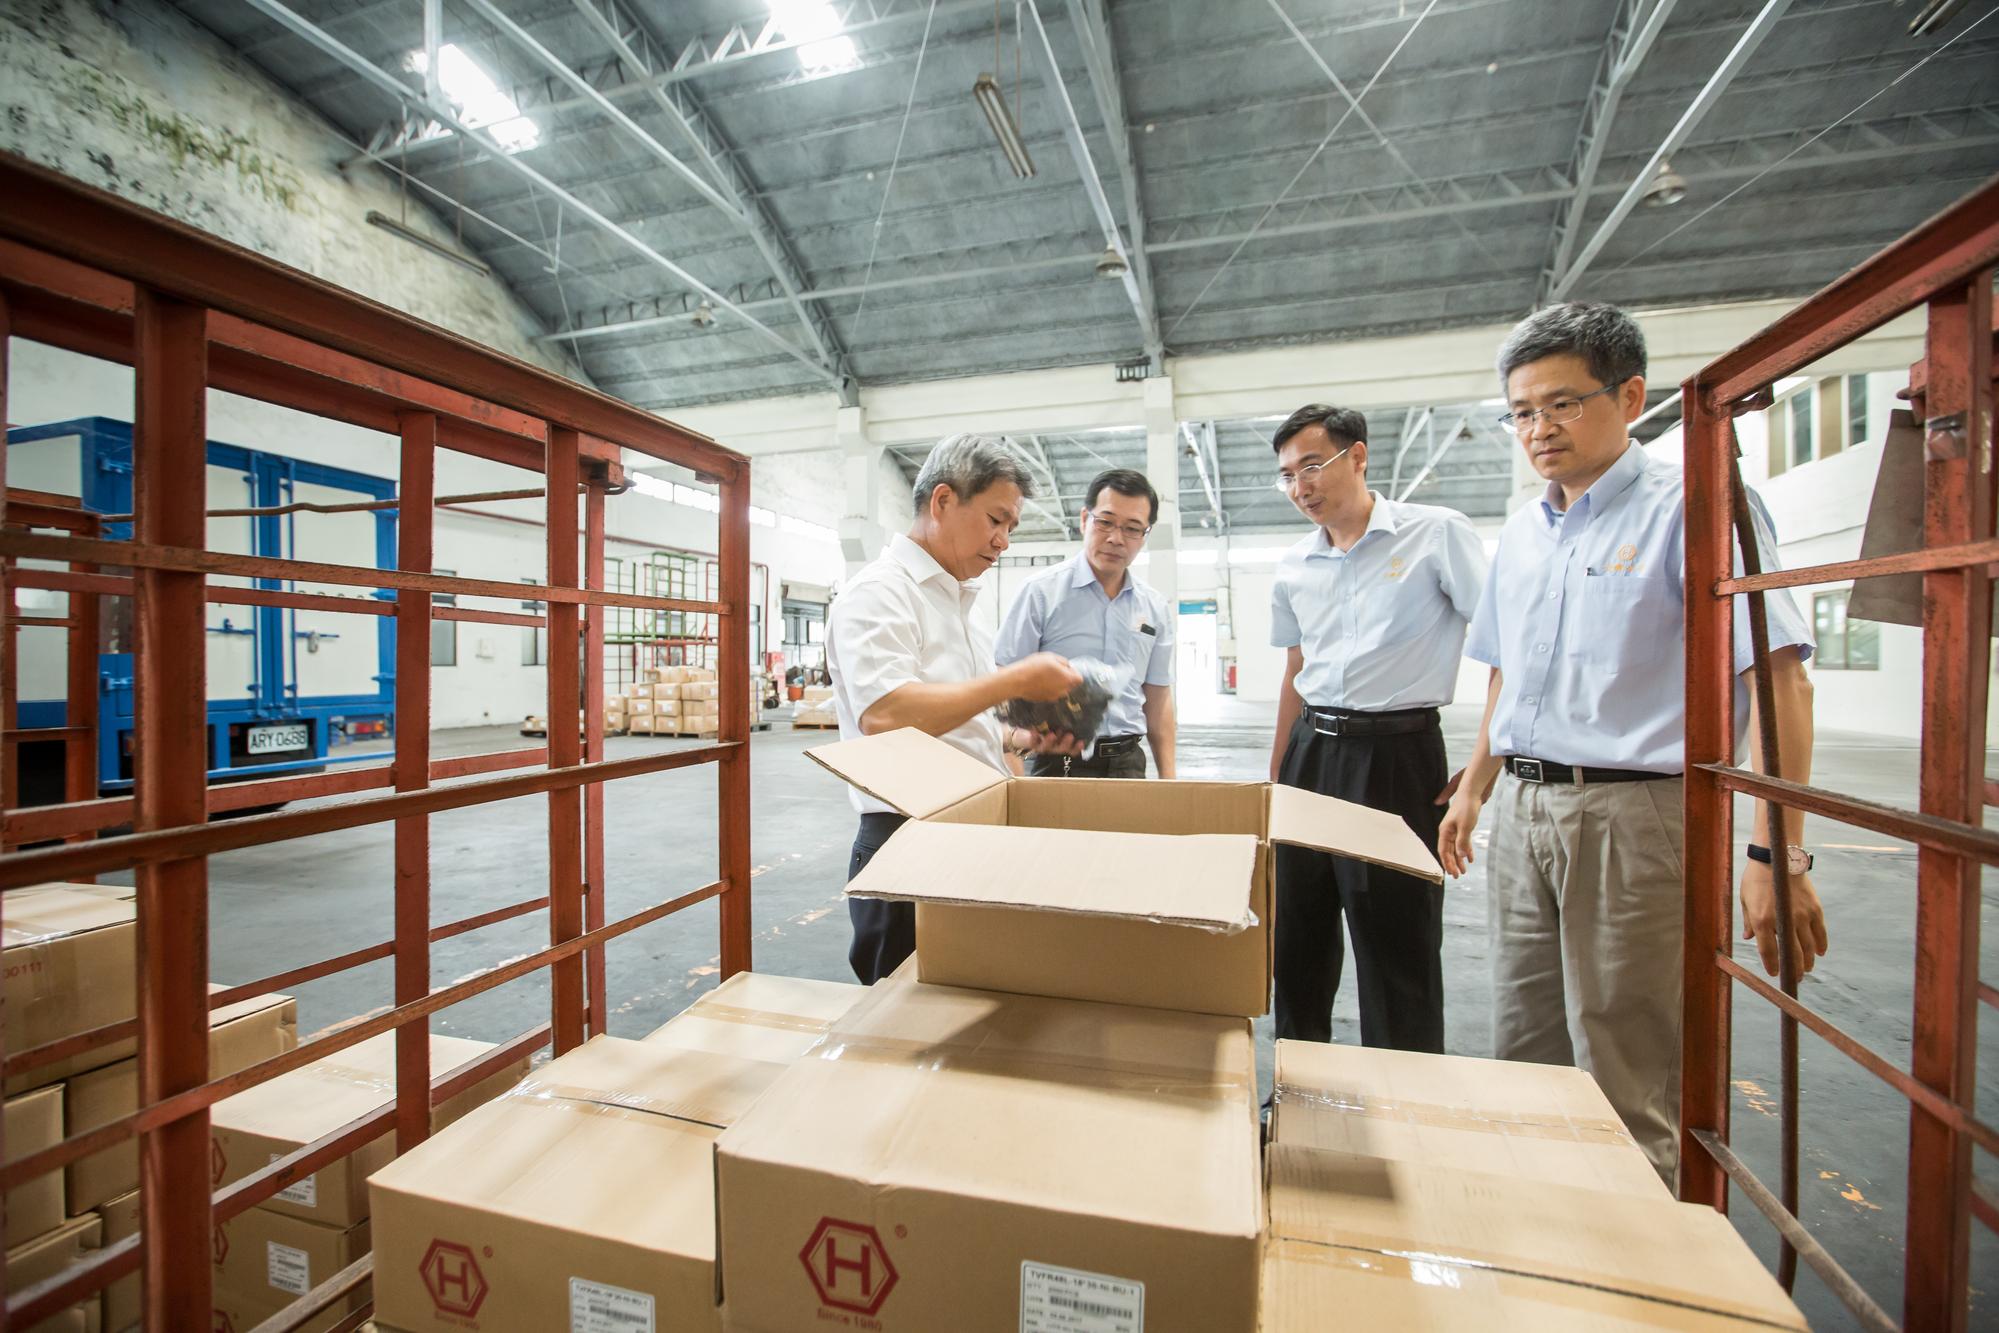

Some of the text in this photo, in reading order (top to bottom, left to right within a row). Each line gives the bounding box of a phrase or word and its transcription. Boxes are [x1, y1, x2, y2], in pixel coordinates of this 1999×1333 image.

[251, 732, 273, 749] ARY
[438, 1255, 469, 1302] H
[827, 1237, 870, 1296] H
